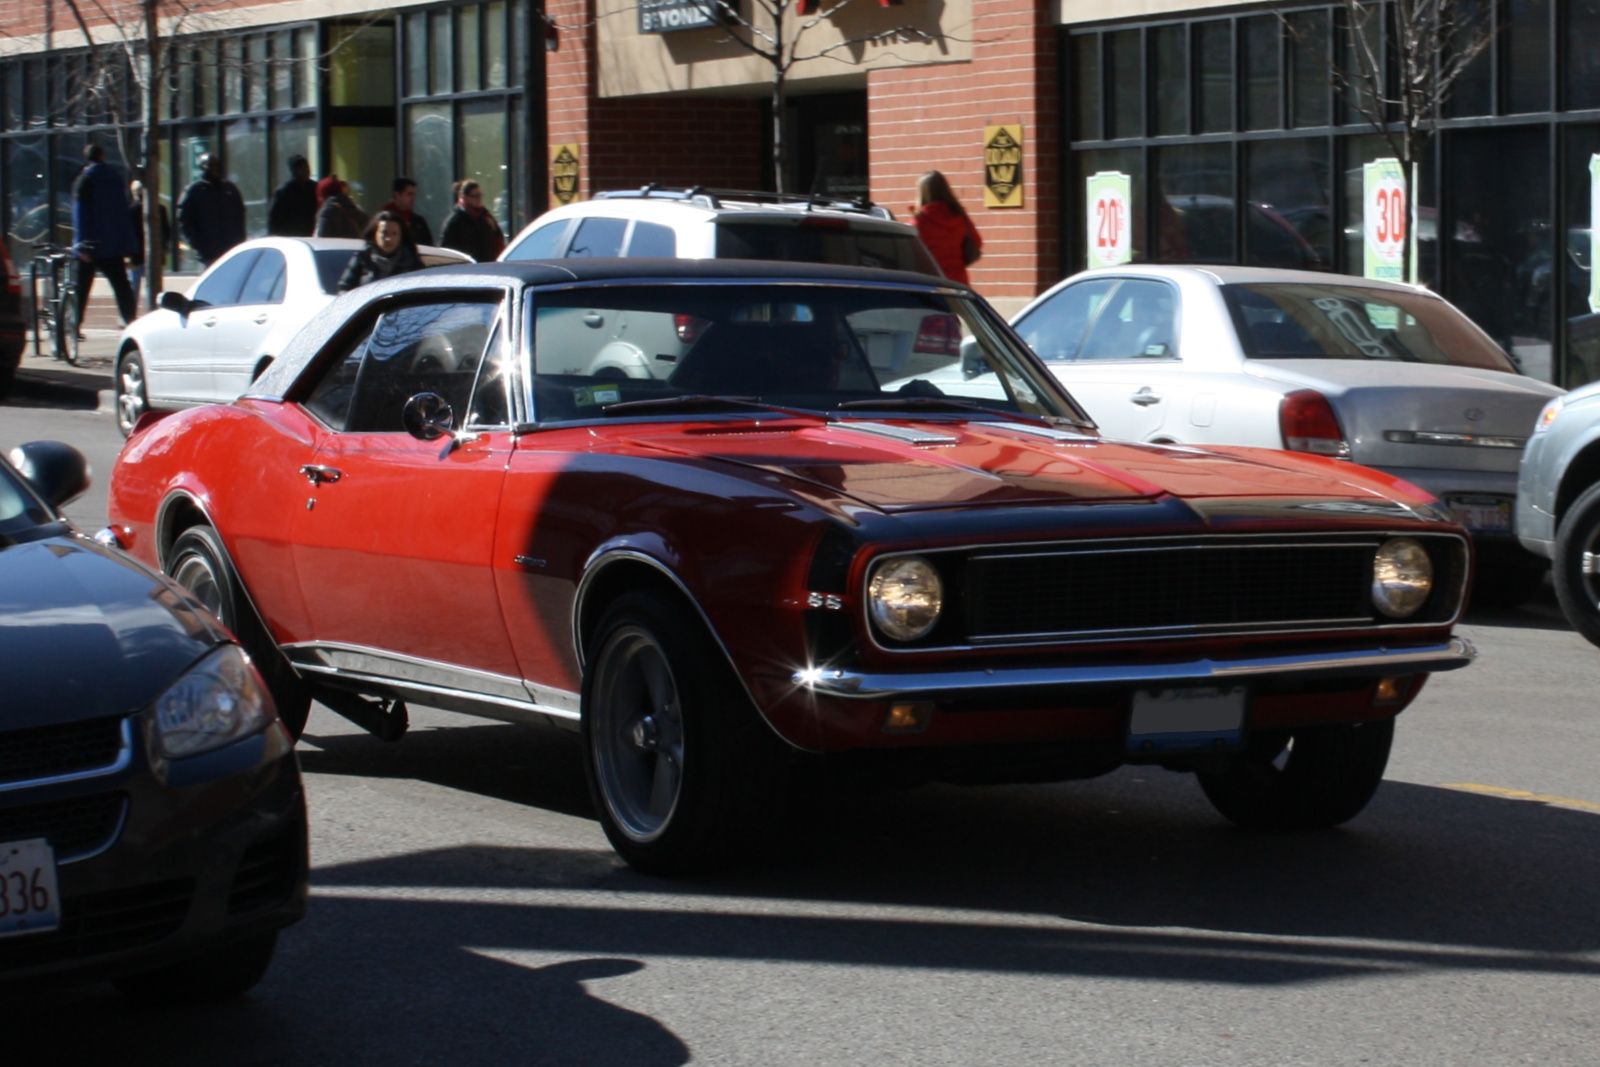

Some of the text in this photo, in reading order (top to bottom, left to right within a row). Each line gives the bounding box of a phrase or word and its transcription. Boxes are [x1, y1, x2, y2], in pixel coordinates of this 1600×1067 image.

[643, 6, 711, 31] BEYOND
[1096, 198, 1118, 248] 20
[1377, 188, 1406, 243] 30
[806, 591, 842, 611] SS
